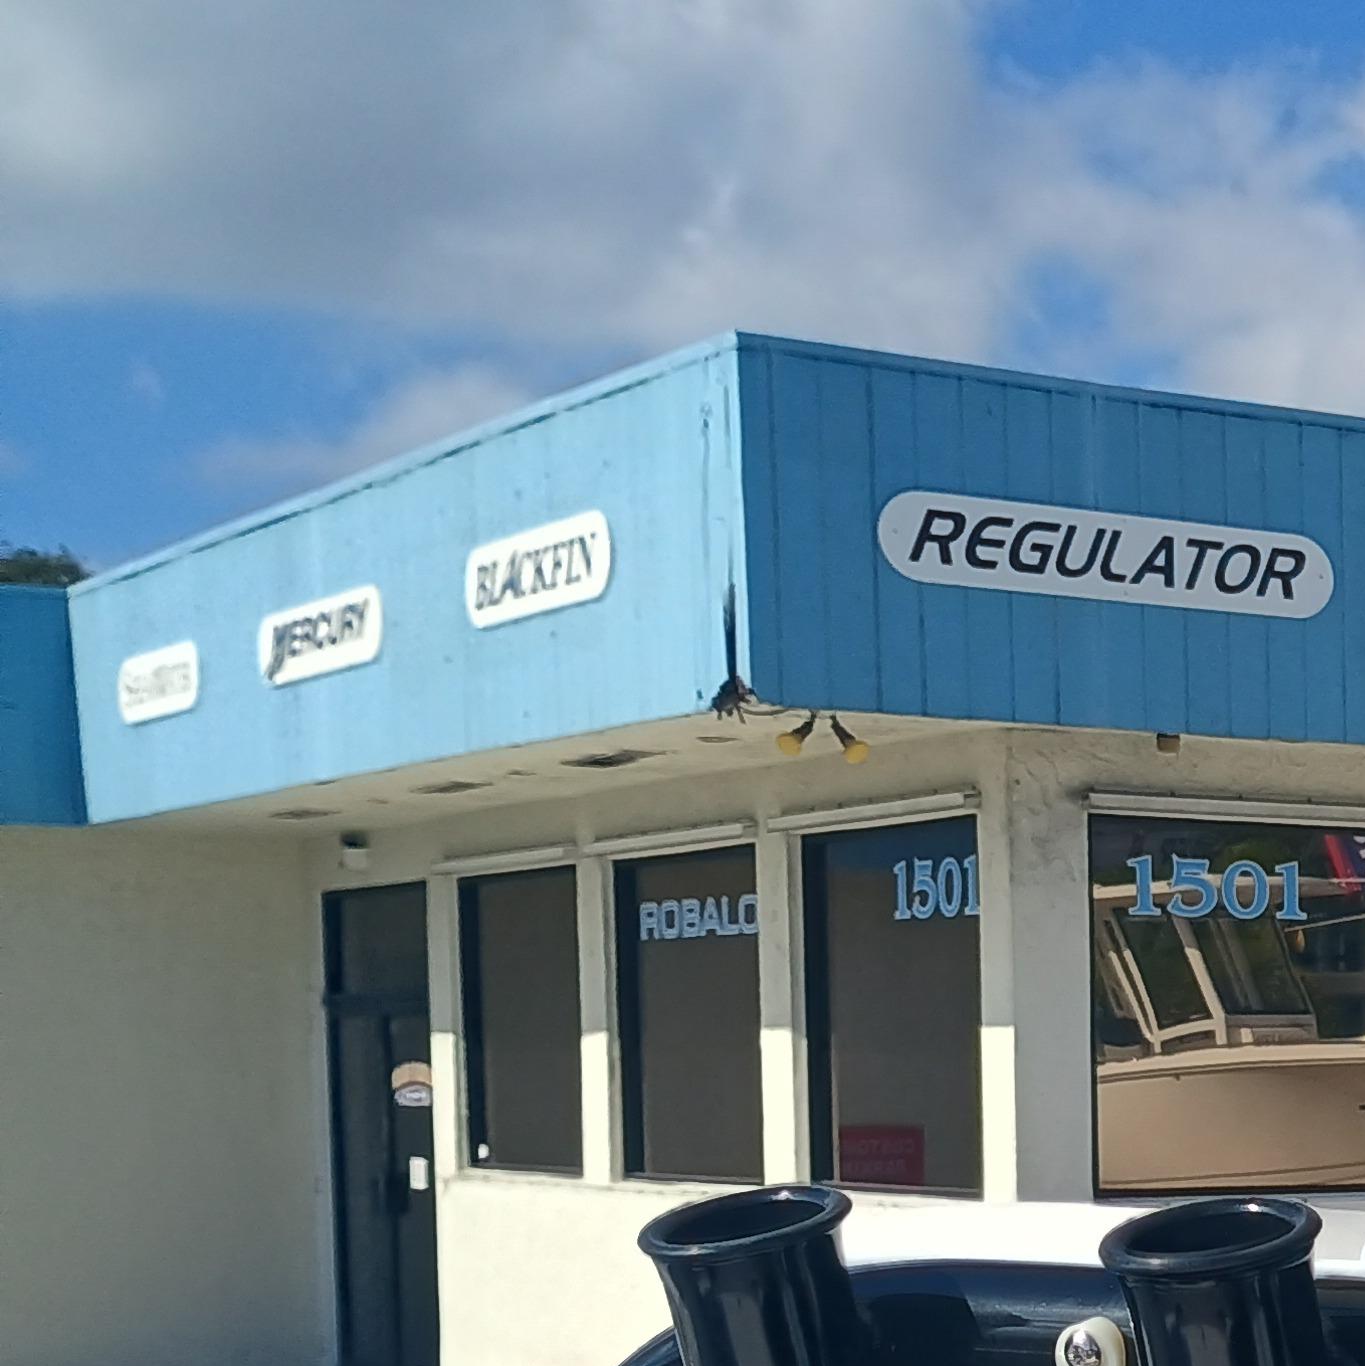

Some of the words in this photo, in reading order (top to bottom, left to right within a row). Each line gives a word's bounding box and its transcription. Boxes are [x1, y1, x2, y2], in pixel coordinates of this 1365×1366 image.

[474, 532, 596, 611] BLACKFIN
[908, 508, 1307, 600] REGULATOR
[266, 597, 368, 681] MERCURY
[639, 893, 759, 941] ROBALO
[893, 853, 981, 921] 1501
[1126, 853, 1308, 920] 1501
